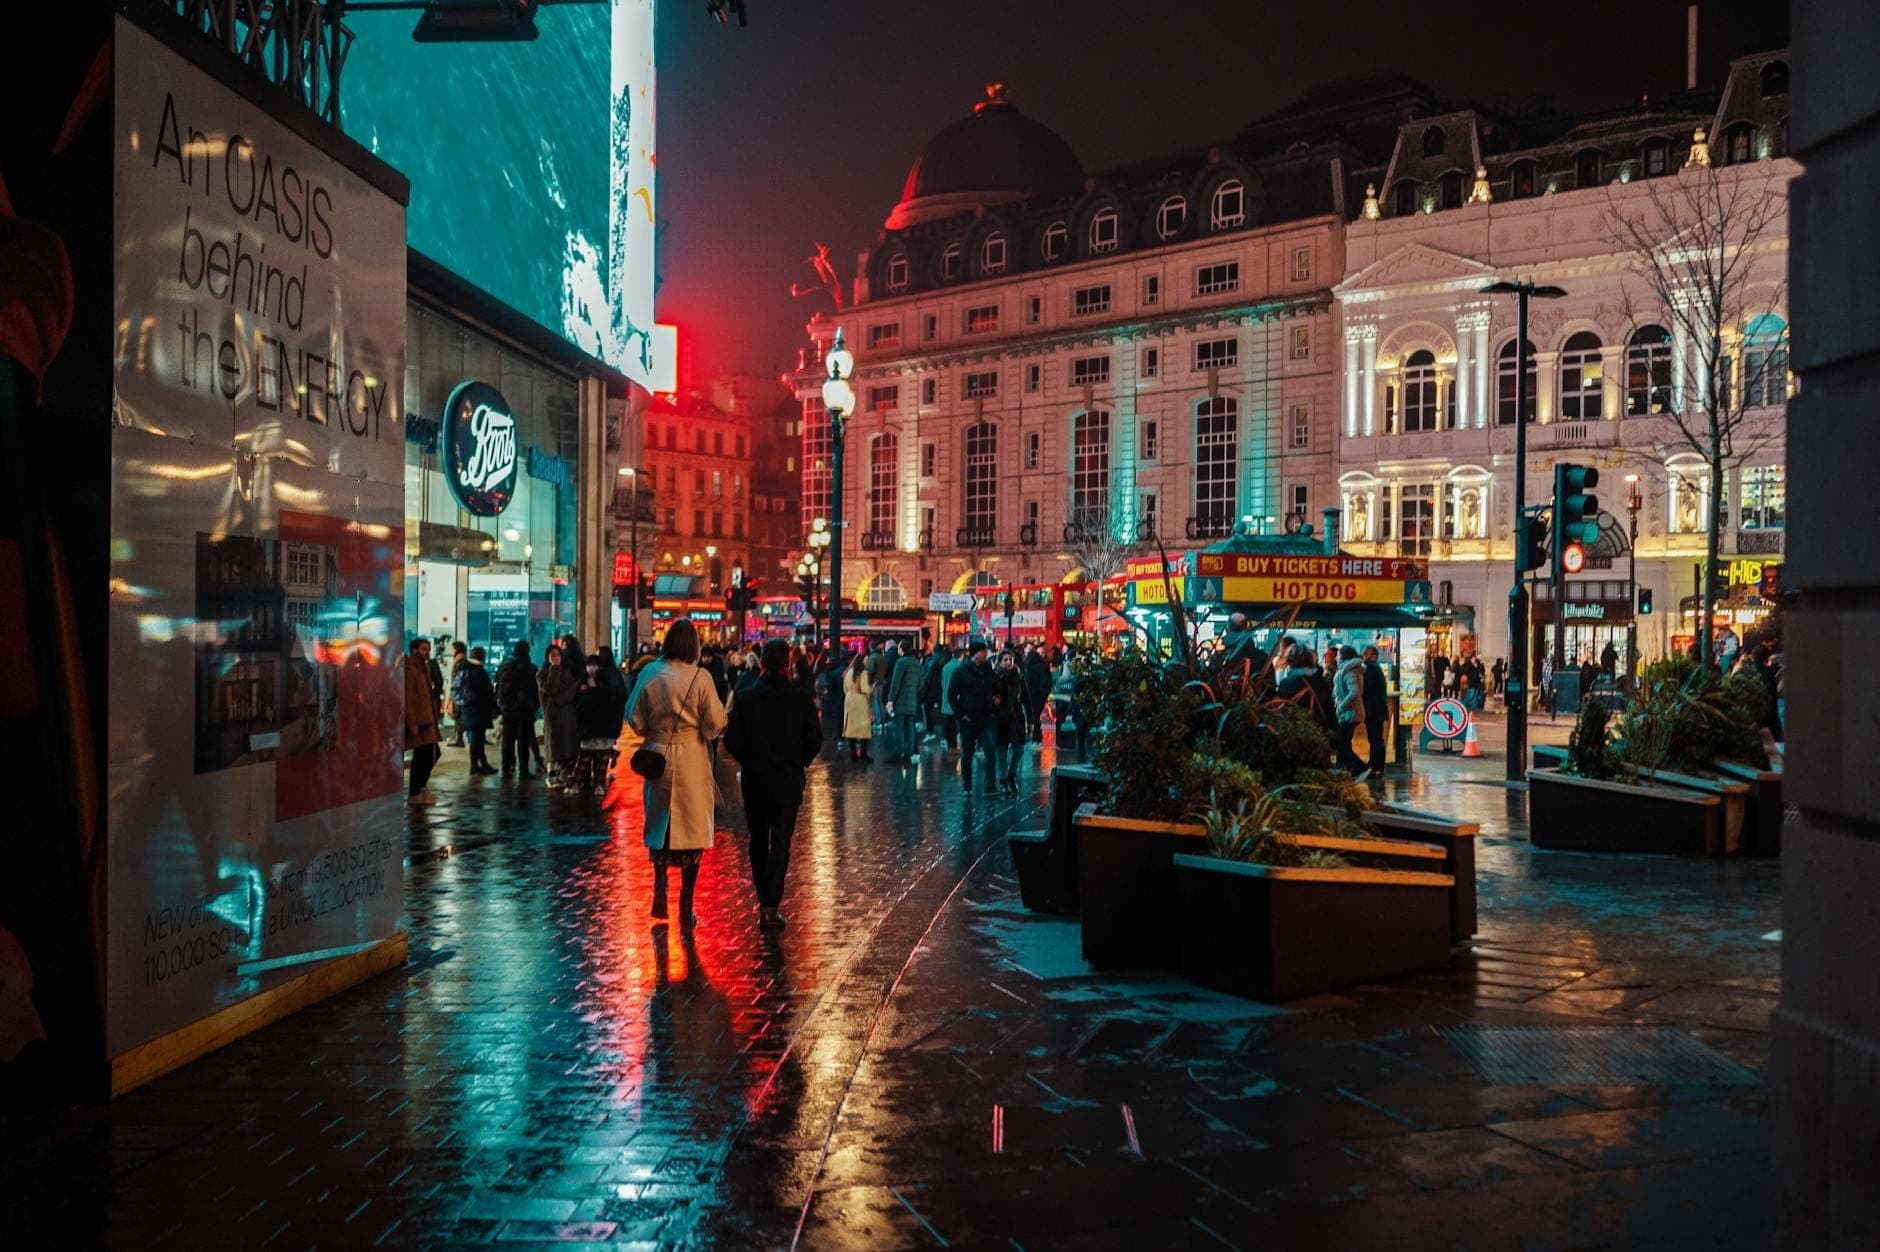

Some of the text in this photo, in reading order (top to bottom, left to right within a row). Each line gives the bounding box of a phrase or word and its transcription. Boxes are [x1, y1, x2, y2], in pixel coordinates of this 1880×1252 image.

[153, 91, 333, 259] An OASIS
[179, 206, 307, 332] behind
[178, 309, 388, 441] the ENERGY
[460, 404, 516, 491] Boots
[531, 448, 567, 489] beauty
[1236, 557, 1270, 574] BUY
[1273, 557, 1339, 576] TICKETS
[1341, 559, 1383, 577] HERE
[1272, 581, 1357, 600] HOTDOG
[144, 904, 187, 946] NEW
[144, 935, 206, 985] 110,000
[280, 887, 328, 931] UNIQUE
[331, 869, 386, 912] LOCATION
